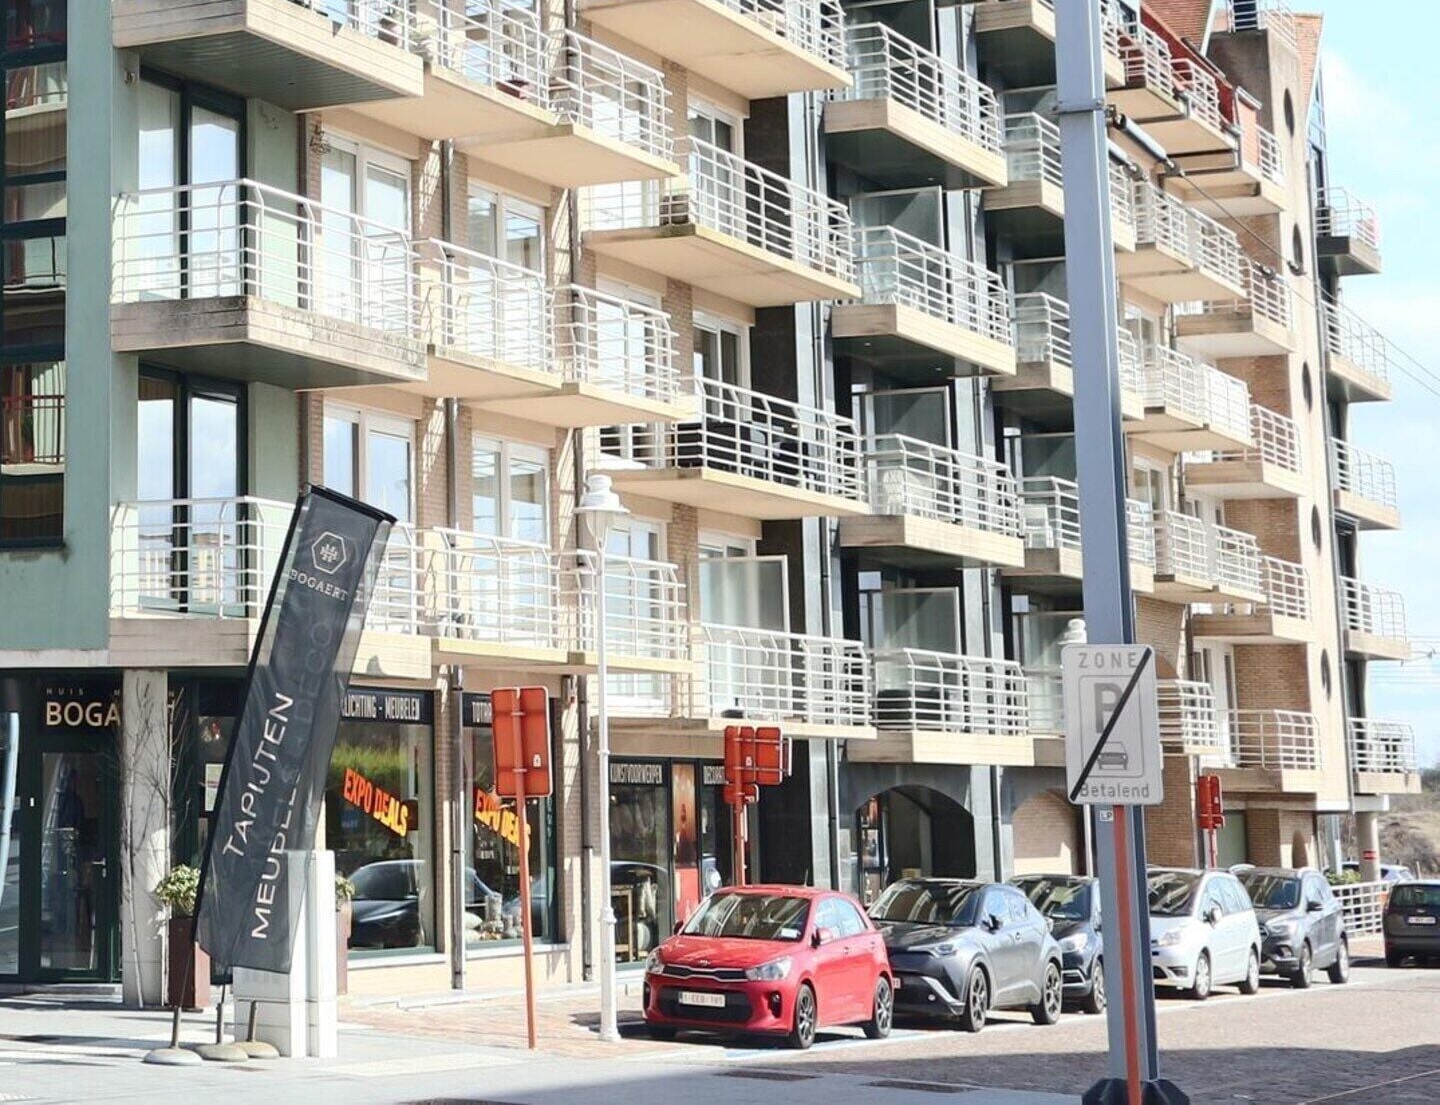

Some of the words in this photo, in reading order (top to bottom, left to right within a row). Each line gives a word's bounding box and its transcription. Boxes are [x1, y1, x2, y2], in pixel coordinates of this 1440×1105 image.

[290, 568, 348, 601] BOGAERT
[1078, 652, 1137, 669] ZONE
[46, 701, 121, 727] BOGA
[385, 696, 420, 721] MEUBELEN
[222, 691, 295, 857] TAPIJTEN
[343, 767, 373, 814] EXPO
[373, 787, 409, 837] DEALS
[1080, 782, 1149, 799] Betalend
